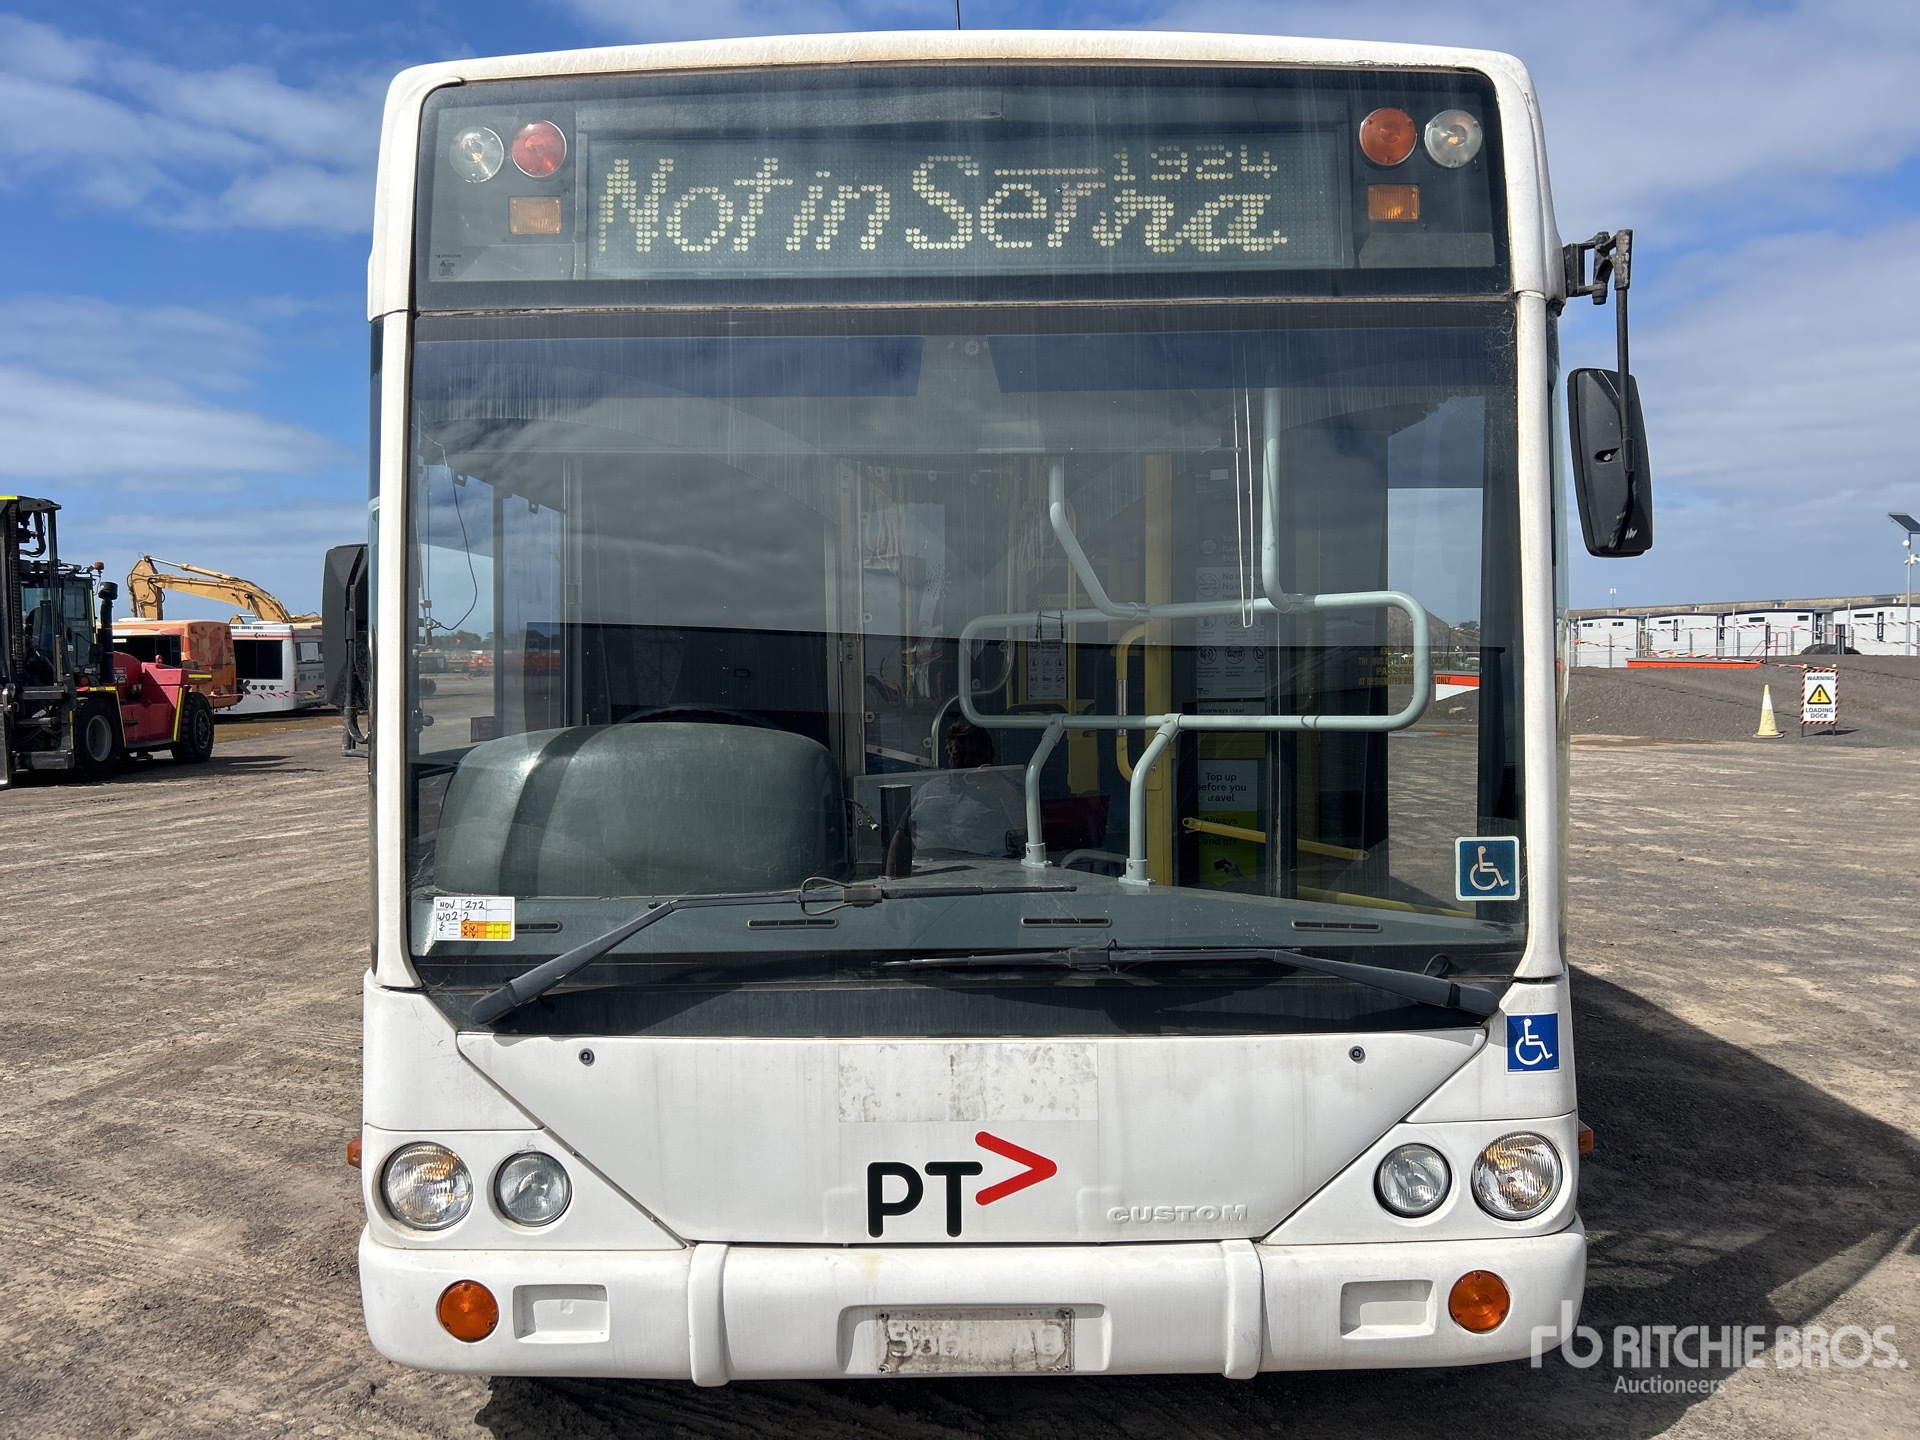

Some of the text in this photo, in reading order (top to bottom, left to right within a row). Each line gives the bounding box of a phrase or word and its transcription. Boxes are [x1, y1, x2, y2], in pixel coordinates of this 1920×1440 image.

[1204, 772, 1237, 783] Top up
[1229, 785, 1247, 793] you
[1106, 1204, 1249, 1225] CUSTOM
